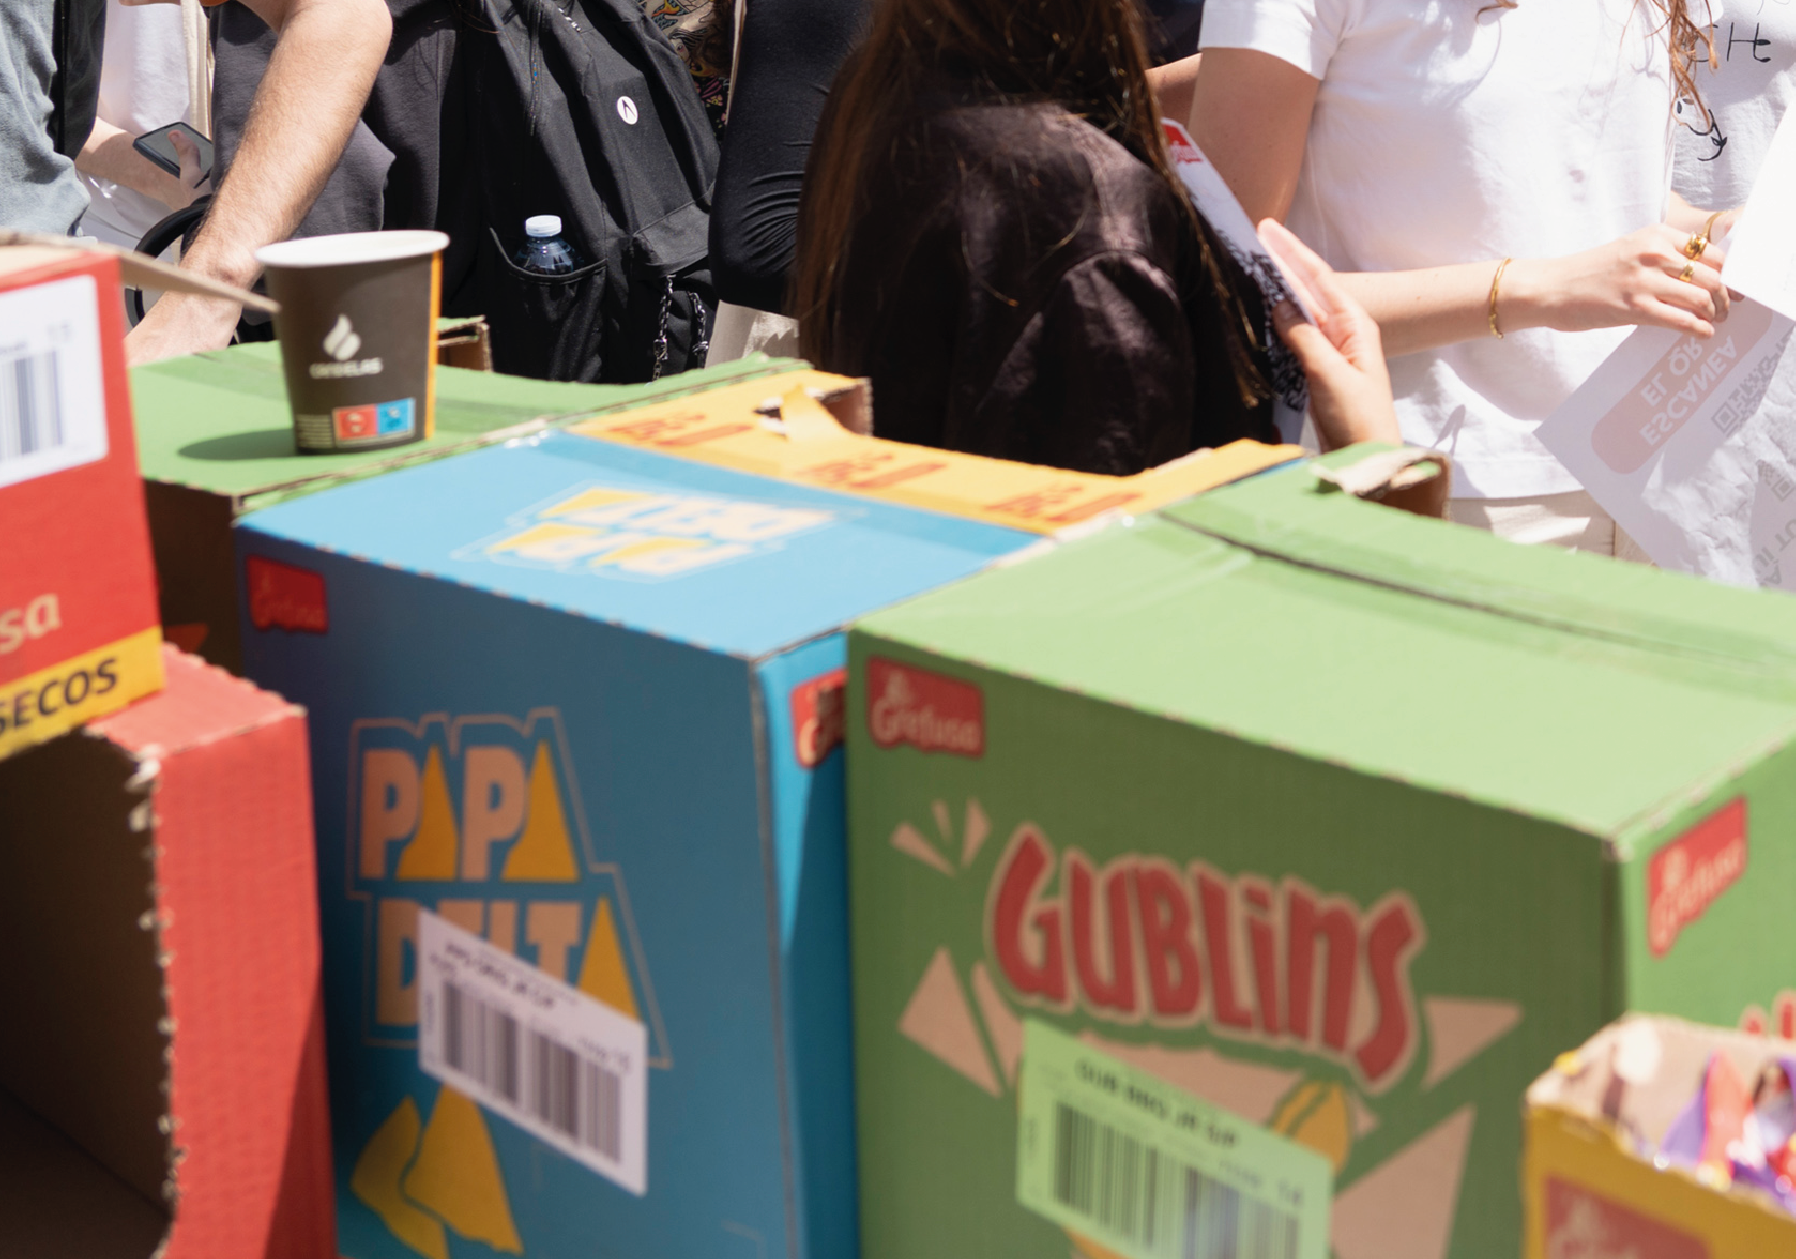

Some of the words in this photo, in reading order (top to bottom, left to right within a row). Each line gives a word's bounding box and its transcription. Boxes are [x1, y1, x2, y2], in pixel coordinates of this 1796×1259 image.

[870, 696, 982, 752] Grefusa
[360, 739, 577, 883] PAPA
[375, 895, 642, 1026] DTA
